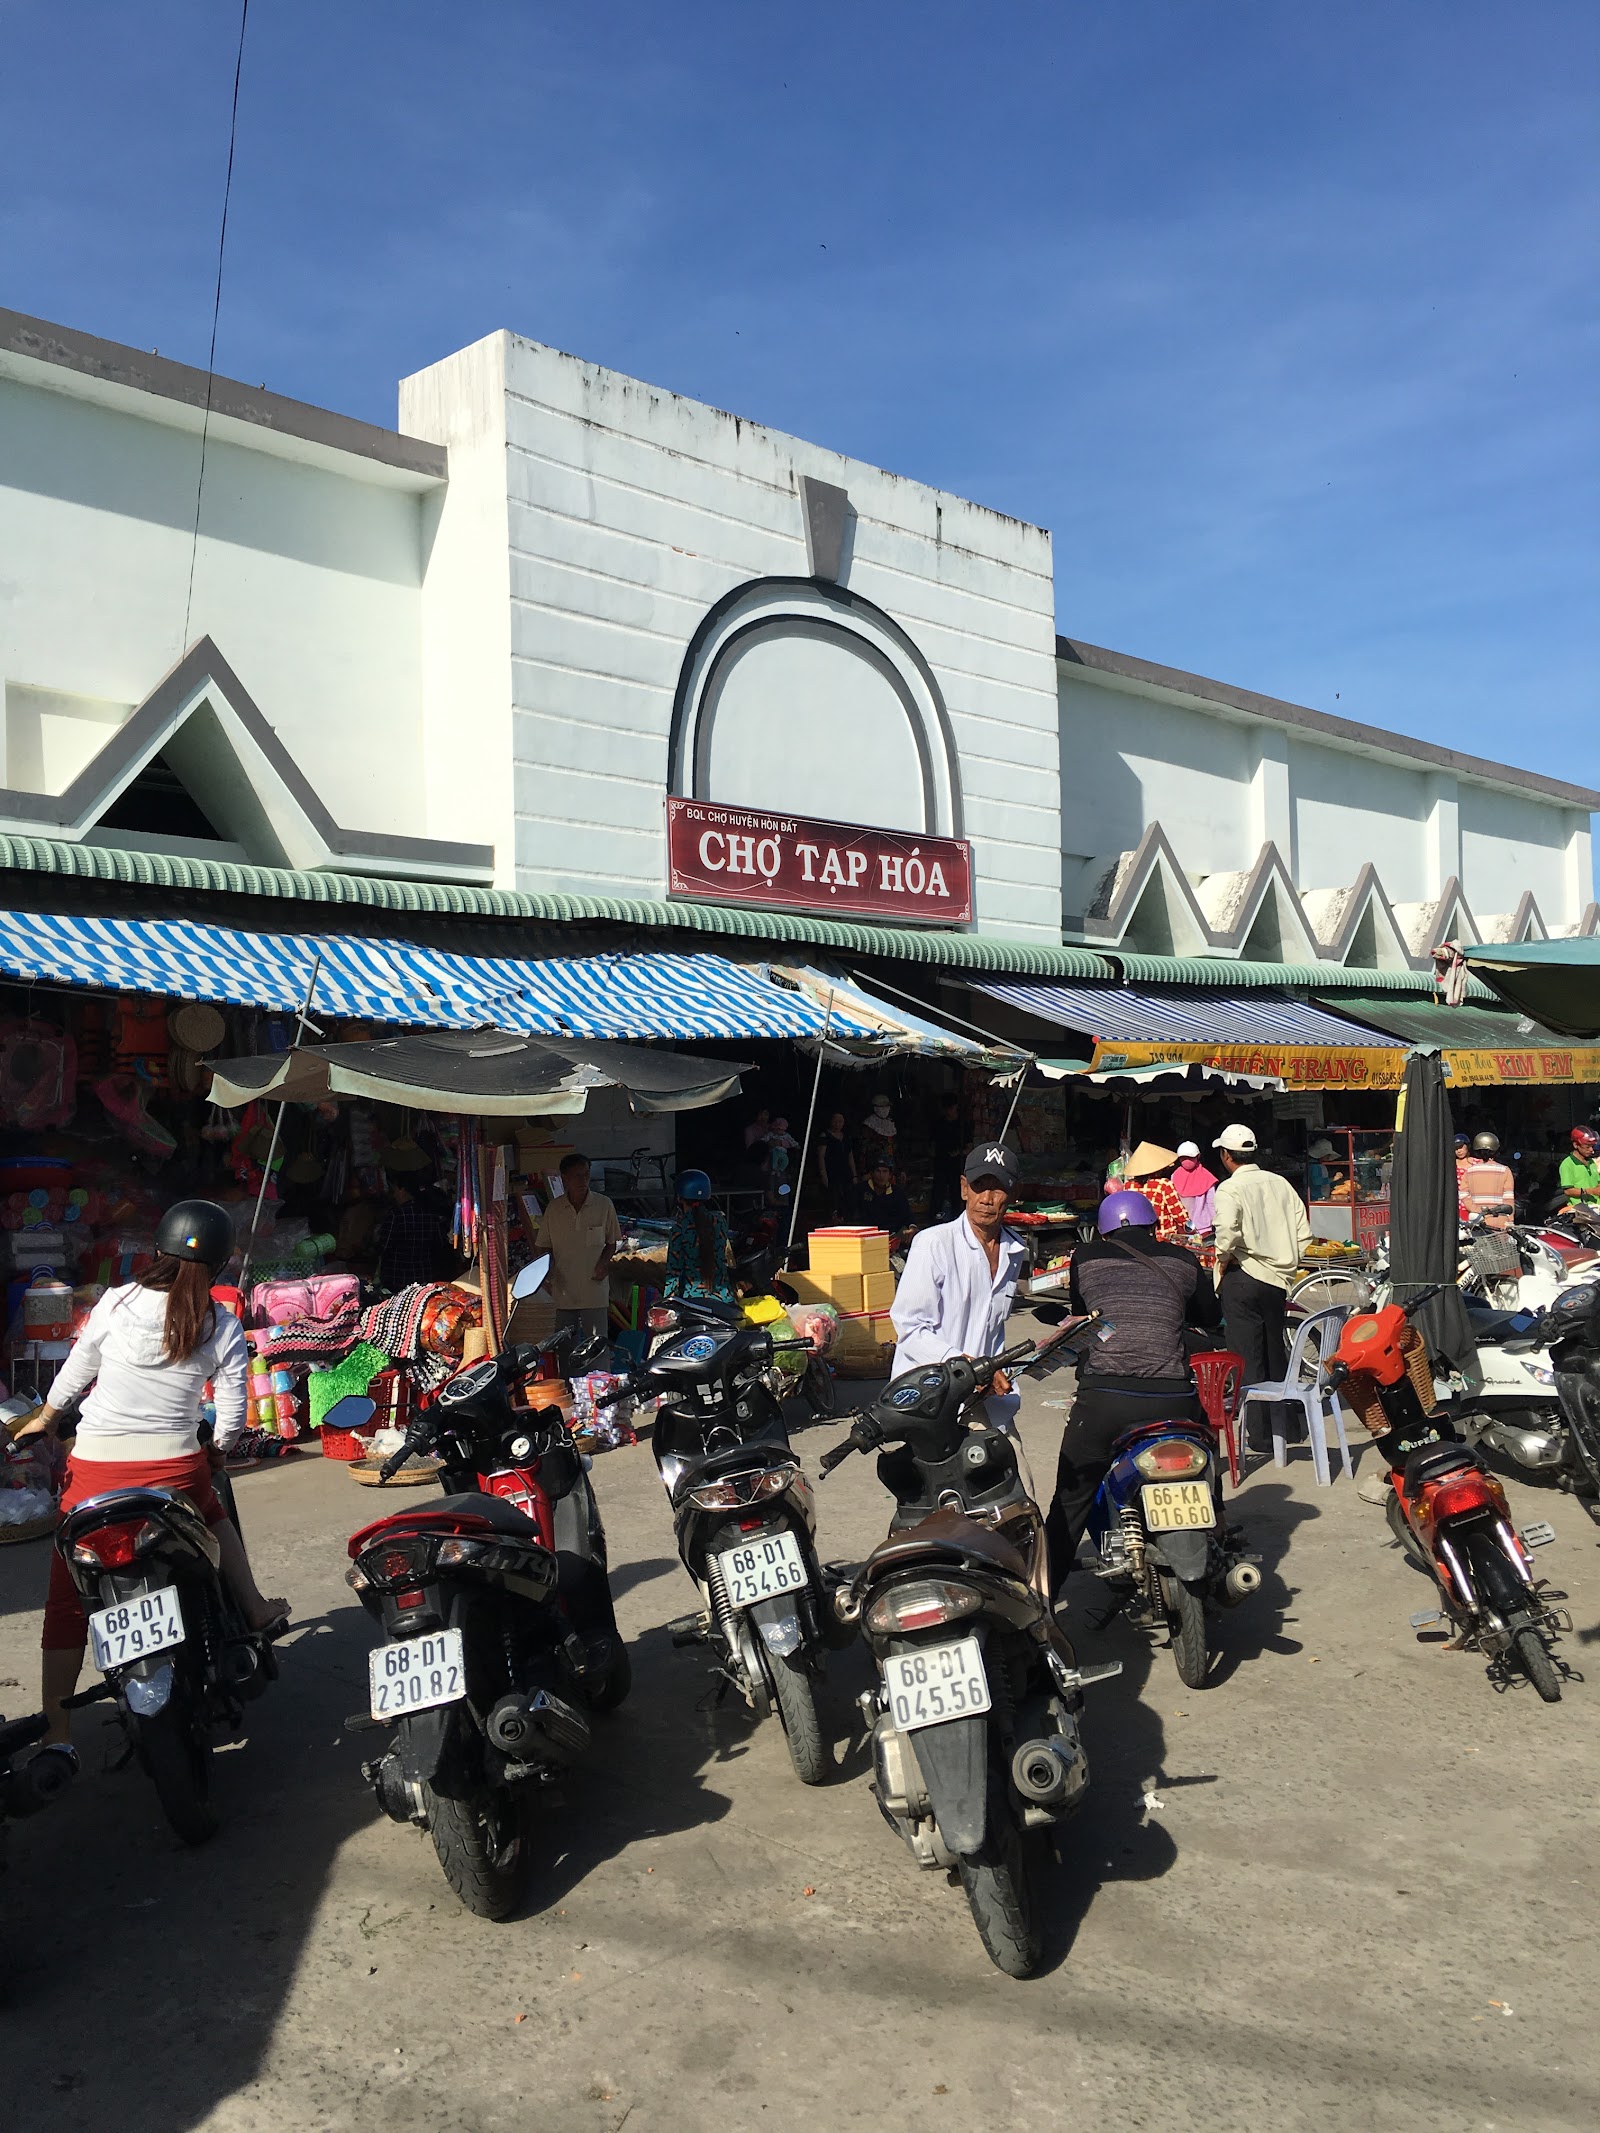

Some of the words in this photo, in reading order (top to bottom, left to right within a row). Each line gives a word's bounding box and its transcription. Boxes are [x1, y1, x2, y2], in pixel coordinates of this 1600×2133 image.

[686, 808, 706, 821] BQL
[707, 811, 728, 827] CHỢ
[729, 814, 759, 830] HUYỆN
[760, 817, 778, 832] HÒN
[780, 819, 798, 834] ĐẤT
[699, 831, 781, 887] CHỢ
[795, 843, 867, 894] TẠP
[878, 847, 950, 897] HÓA
[1290, 1056, 1367, 1082] TRANG
[1493, 1054, 1538, 1078] KIM
[1540, 1054, 1573, 1078] EM
[1480, 1376, 1523, 1386] Grande
[1150, 1505, 1211, 1527] 016.60
[1152, 1485, 1201, 1506] 66-KA
[732, 1539, 786, 1574] 68-D1
[732, 1561, 802, 1602] 254.66
[105, 1594, 164, 1635] 68-D1
[101, 1616, 178, 1663] 179.54
[385, 1636, 446, 1677] 68-D1
[900, 1646, 966, 1688] 68-D1
[377, 1666, 458, 1712] 230.82
[896, 1677, 983, 1725] 045.56
